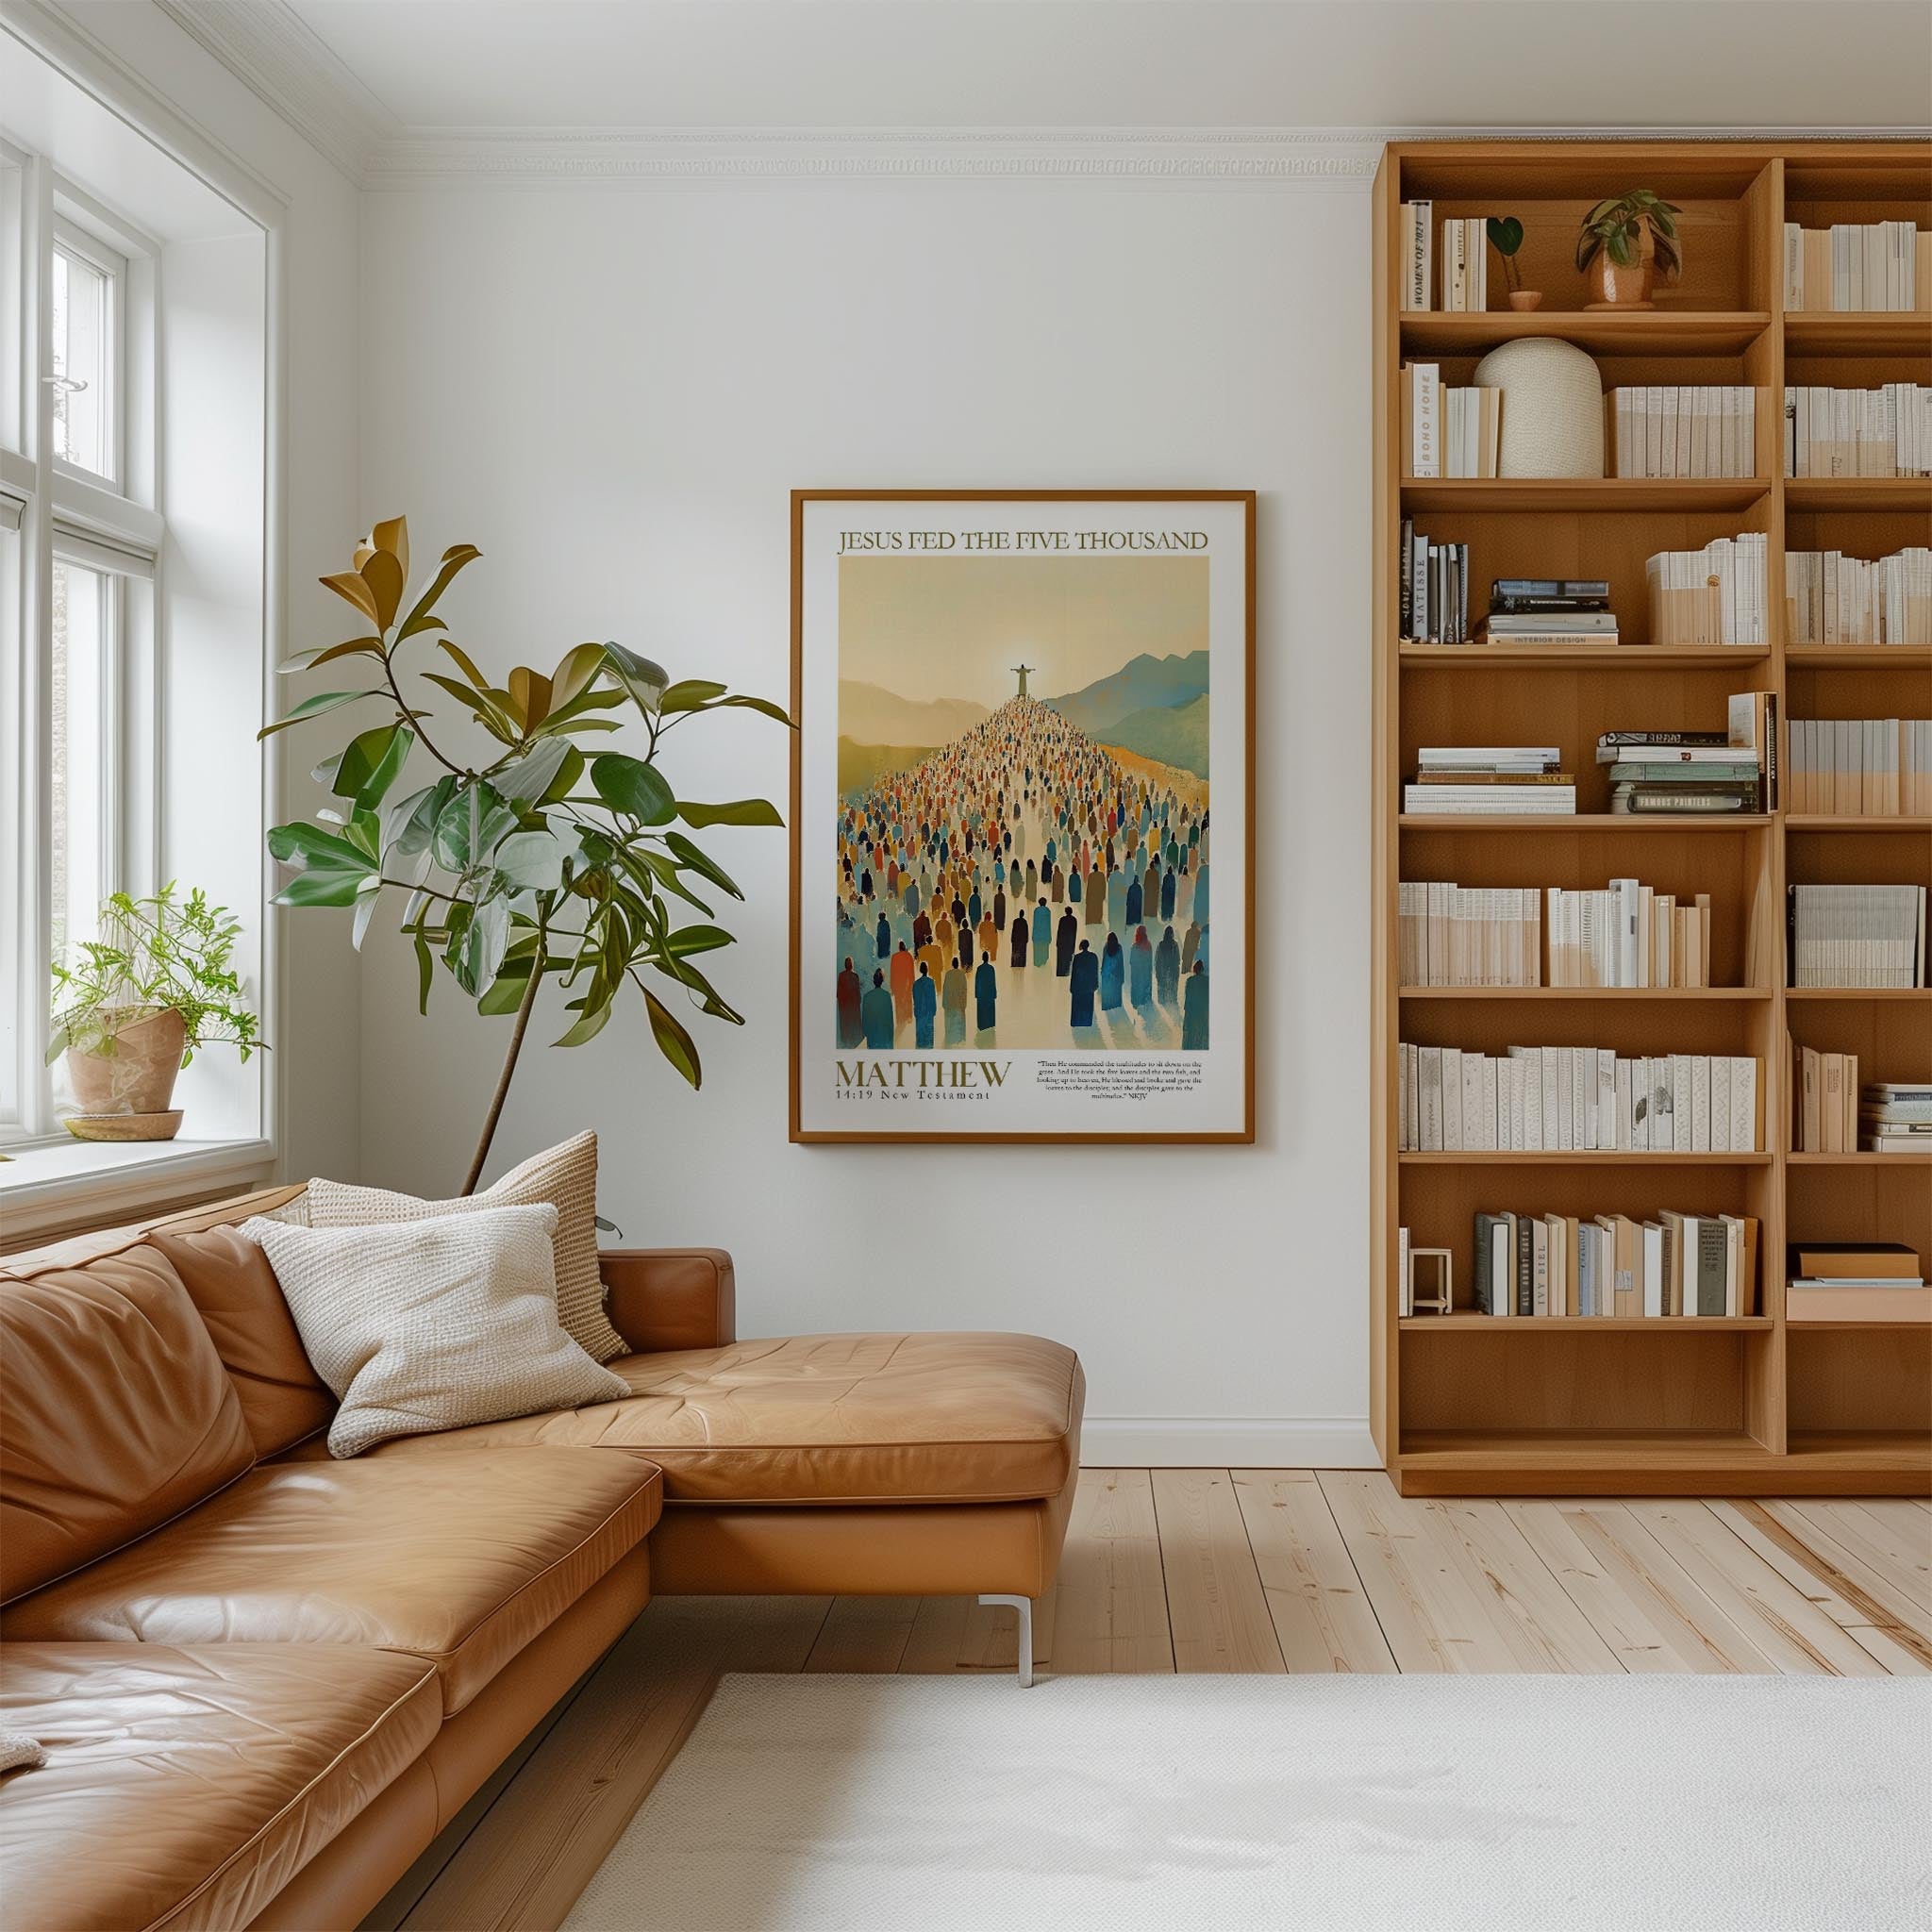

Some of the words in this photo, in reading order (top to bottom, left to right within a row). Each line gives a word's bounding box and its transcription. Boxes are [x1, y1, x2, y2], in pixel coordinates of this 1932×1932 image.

[1414, 221, 1424, 243] 2024
[1414, 244, 1424, 259] OF
[1413, 261, 1424, 305] WOMEN
[1422, 375, 1430, 414] HOME
[1422, 422, 1430, 461] BOHO
[838, 531, 903, 555] JESUS
[908, 531, 956, 549] FED
[960, 531, 1011, 549] THE
[1016, 531, 1071, 549] FIVE
[1074, 531, 1209, 549] THOUSAND
[1416, 558, 1424, 624] MATISSE
[1640, 798, 1672, 807] FAMOUS
[1674, 798, 1711, 807] PAINTERS
[835, 1061, 1012, 1087] MATTHEW
[835, 1090, 873, 1099] 14:19
[881, 1090, 909, 1099] New
[917, 1090, 990, 1099] Testament
[1538, 1245, 1546, 1274] BIEL
[1538, 1282, 1546, 1305] IVY
